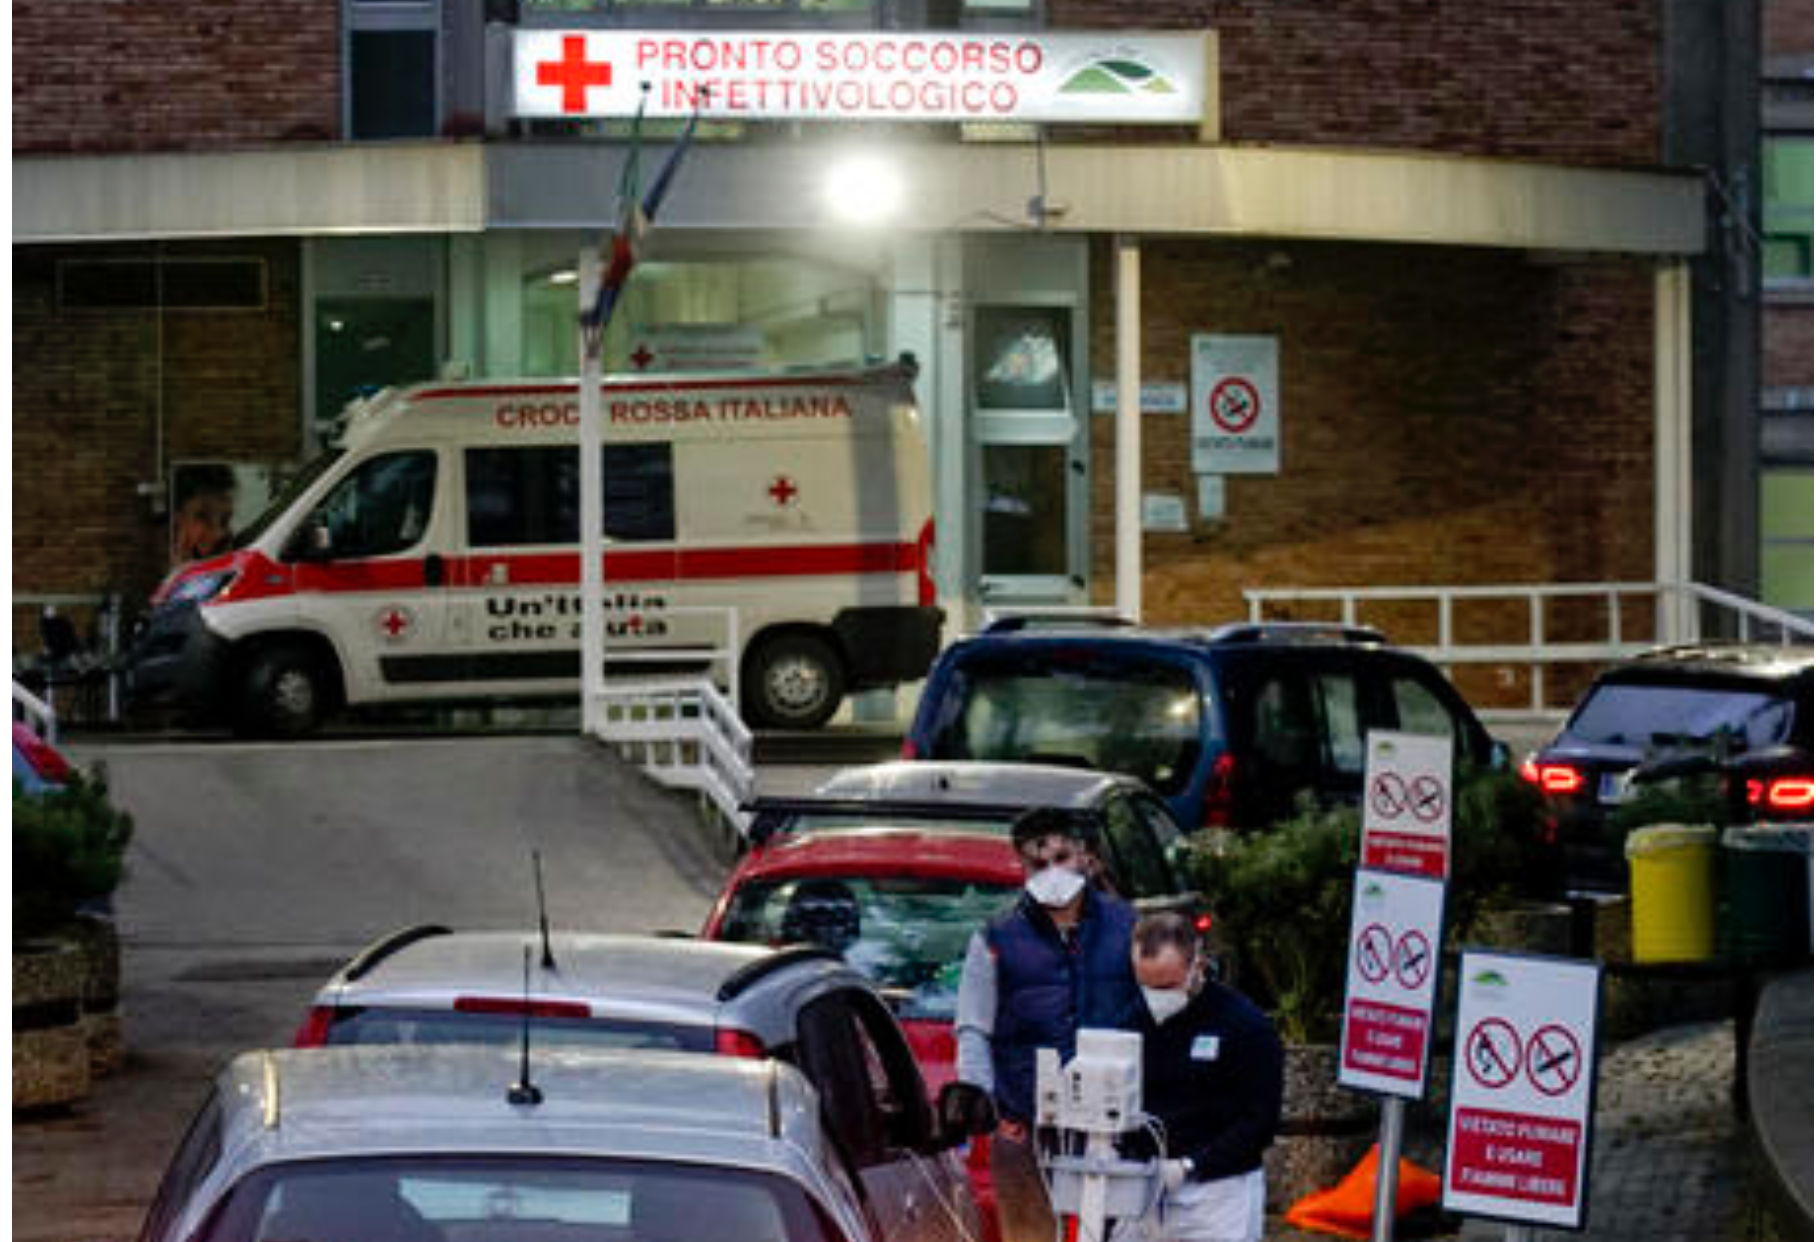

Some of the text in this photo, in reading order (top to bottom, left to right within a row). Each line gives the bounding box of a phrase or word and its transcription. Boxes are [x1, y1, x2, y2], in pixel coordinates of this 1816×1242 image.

[636, 40, 802, 71] PRONTO
[816, 41, 1042, 74] SOCCORSO
[661, 79, 1018, 112] INFETTIVOLOGICO
[496, 394, 852, 428] CROC ROSSA ITALIANA
[487, 593, 667, 616] Un'Itlia
[487, 615, 667, 641] che auta
